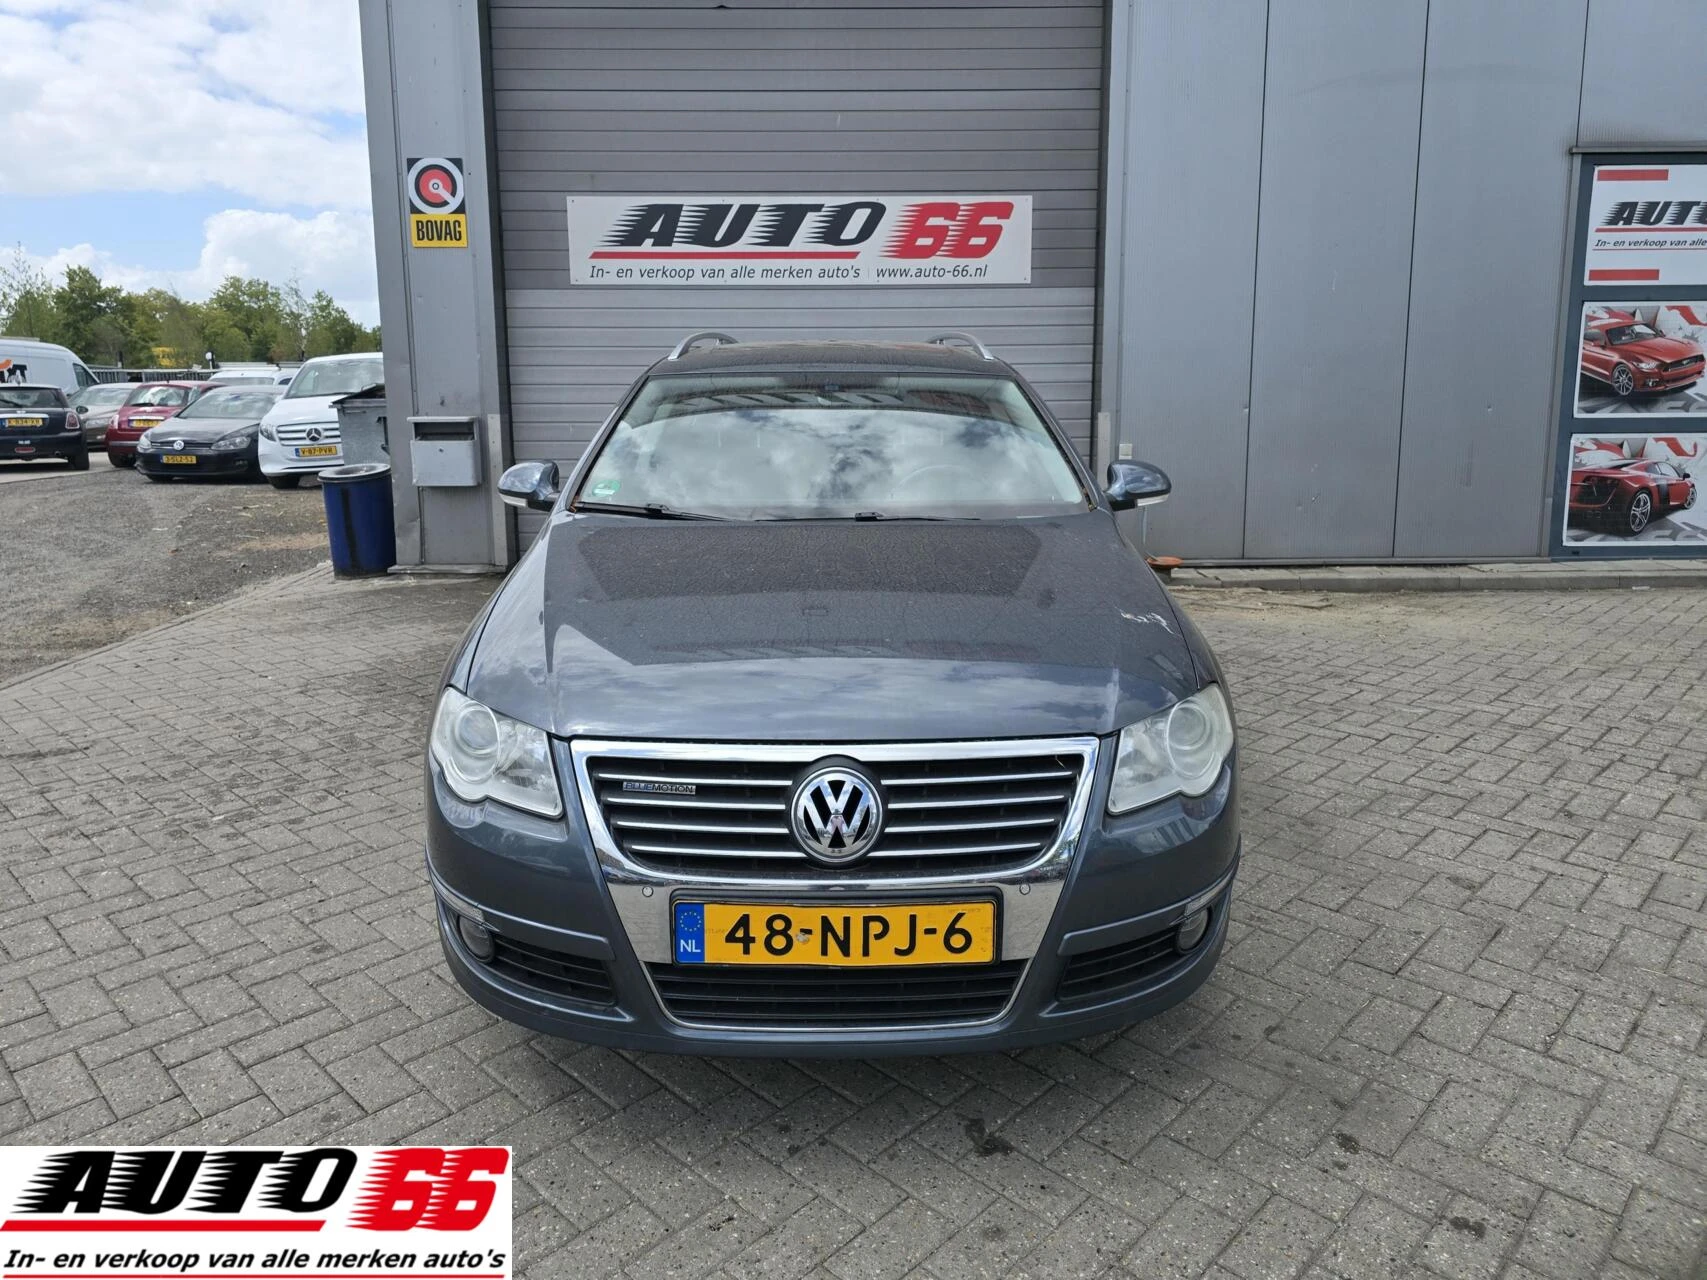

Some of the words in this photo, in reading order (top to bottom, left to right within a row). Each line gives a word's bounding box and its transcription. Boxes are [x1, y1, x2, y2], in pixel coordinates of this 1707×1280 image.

[415, 219, 462, 242] BOVAG
[598, 201, 886, 248] AUTO
[877, 201, 1014, 259] 66
[1594, 239, 1611, 247] In-
[1628, 239, 1668, 248] verkoop
[590, 265, 610, 278] In-
[616, 268, 633, 278] en
[639, 265, 695, 281] verkoop
[701, 268, 725, 278] van
[730, 265, 755, 278] alle
[760, 265, 813, 278] merken
[818, 265, 861, 278] auto's
[876, 264, 988, 278] www.auto-66.nl
[624, 782, 695, 794] BLUEMOTION
[724, 912, 973, 958] 48-NPJ-6
[680, 939, 701, 953] NL
